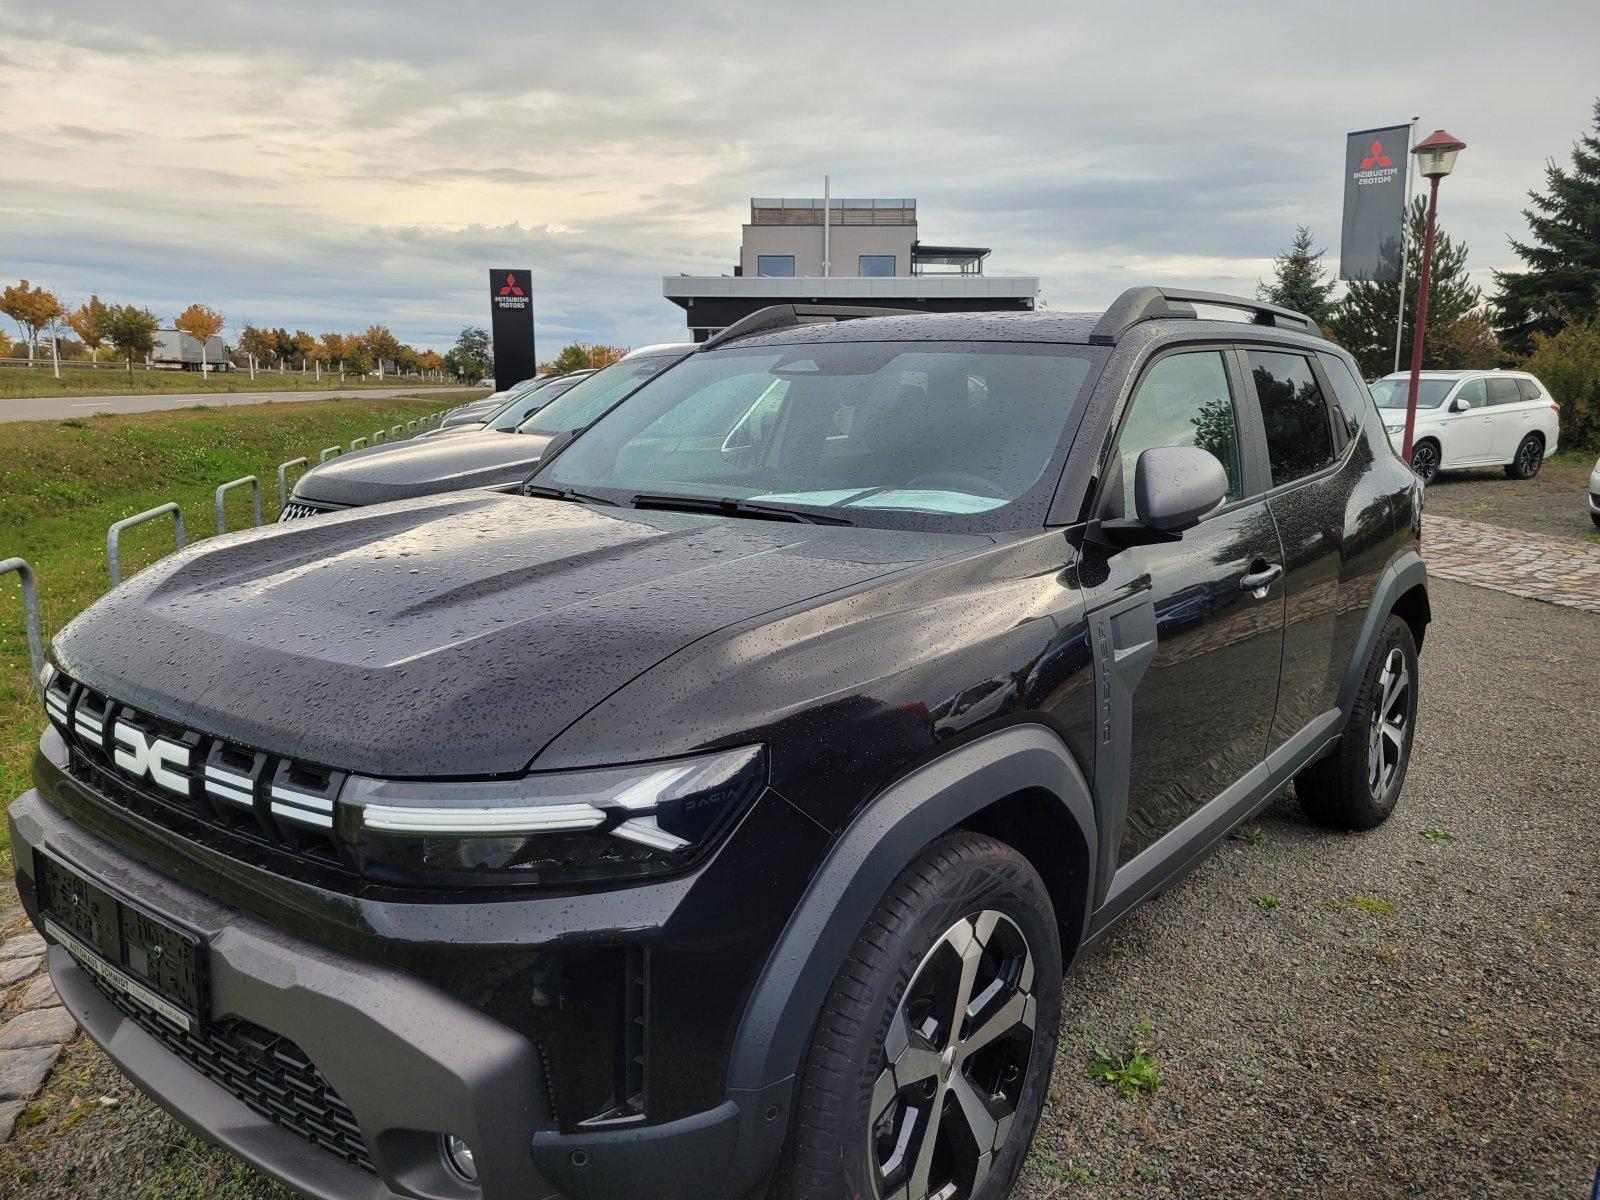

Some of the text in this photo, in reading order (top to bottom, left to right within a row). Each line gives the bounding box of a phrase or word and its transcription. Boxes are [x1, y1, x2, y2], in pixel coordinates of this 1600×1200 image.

[1098, 620, 1111, 745] DUSTER
[70, 941, 129, 991] AUTOHAUS SCHMIDT
